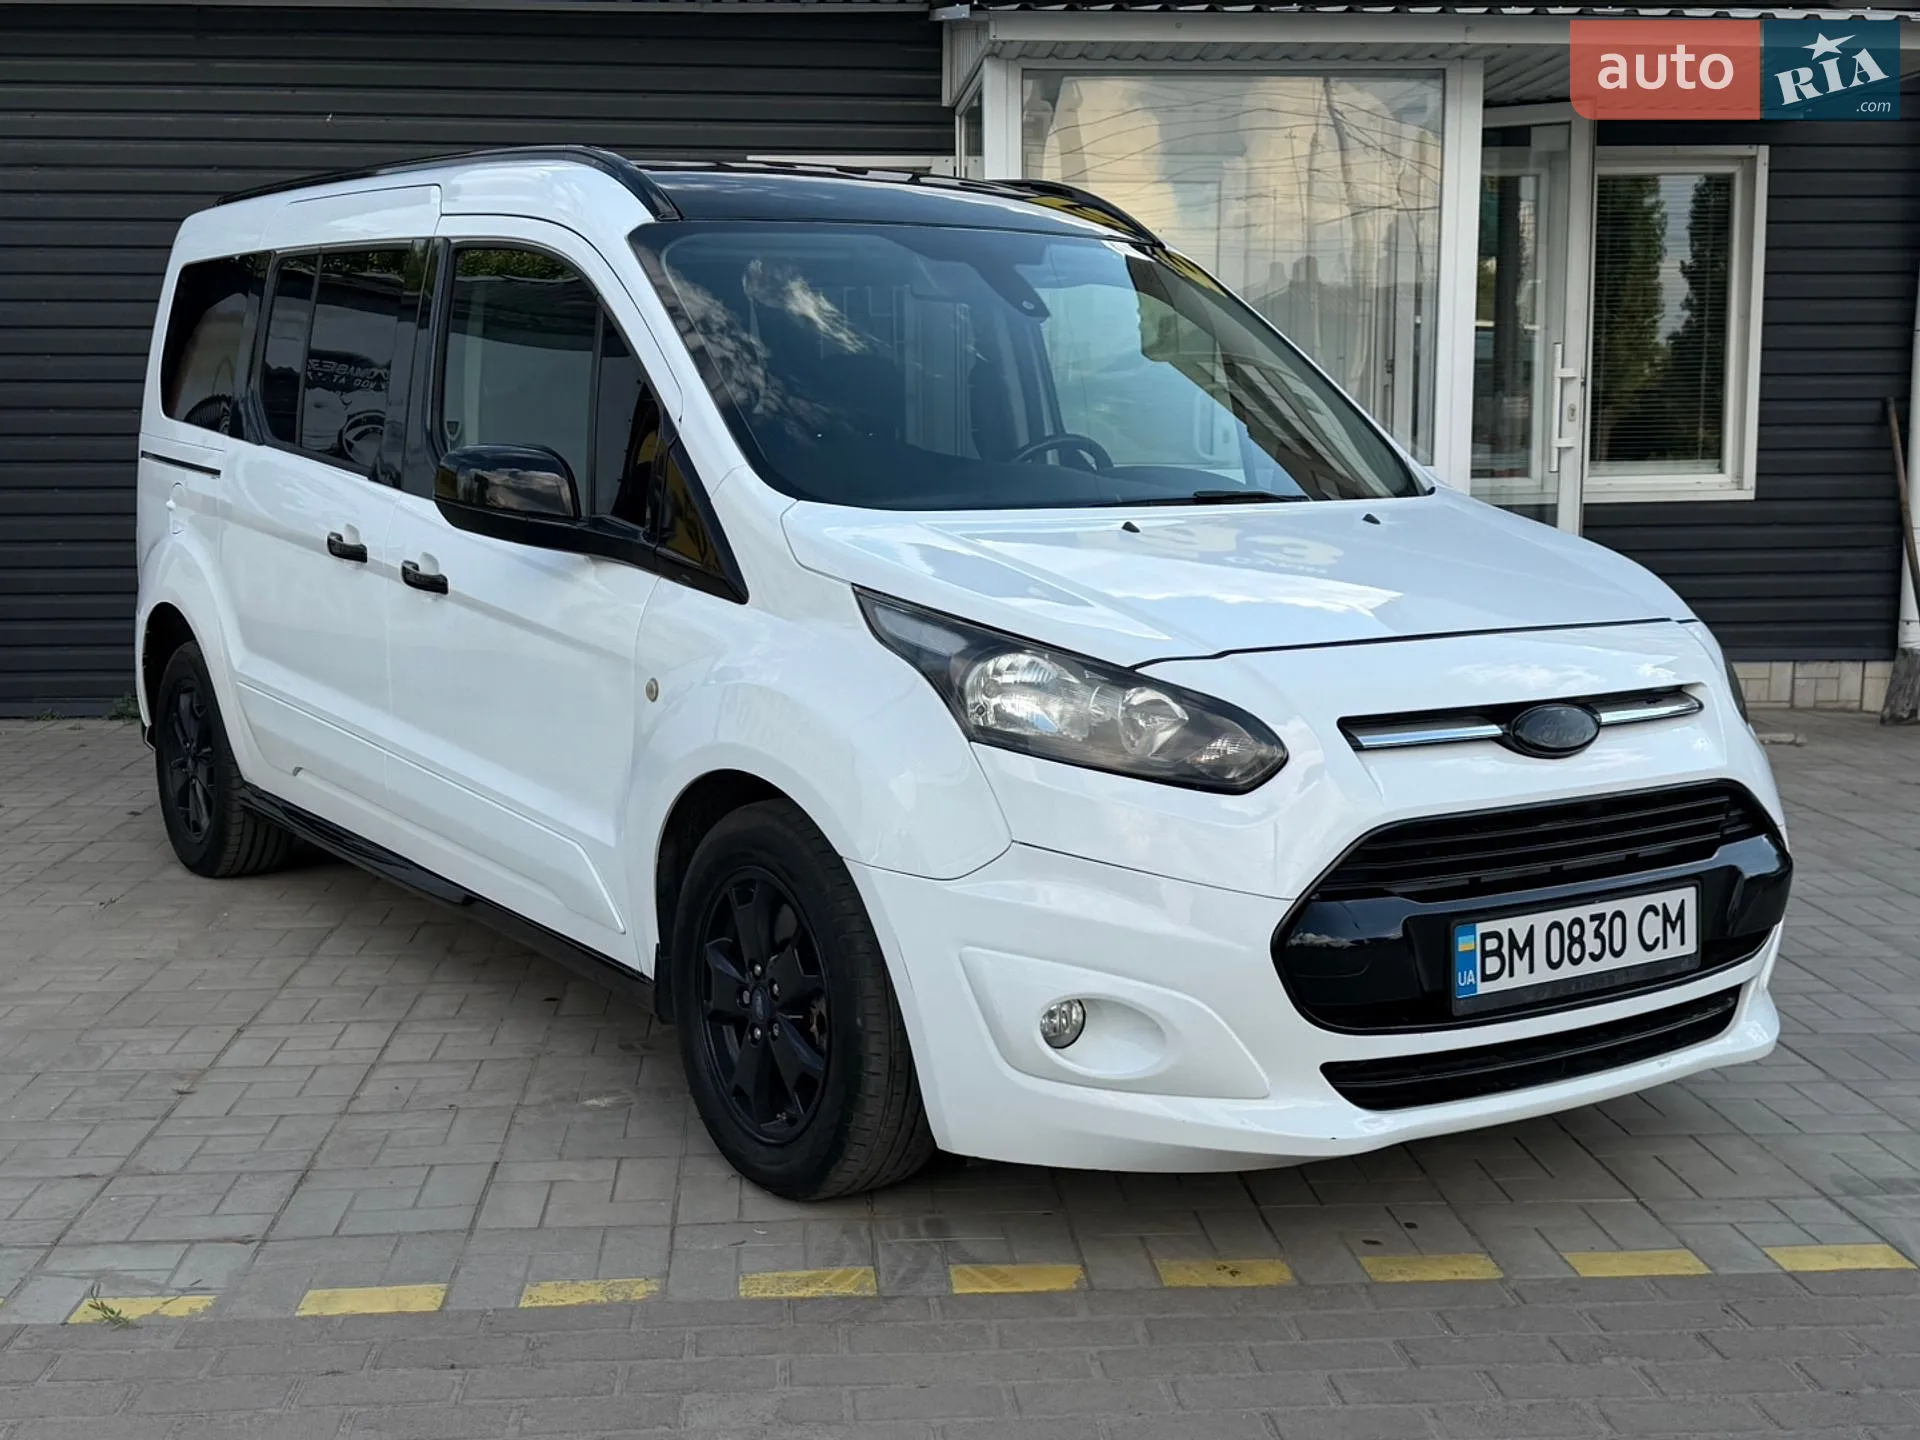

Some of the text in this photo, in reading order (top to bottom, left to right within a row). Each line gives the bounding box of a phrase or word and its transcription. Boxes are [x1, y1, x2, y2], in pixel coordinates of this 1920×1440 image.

[1479, 899, 1685, 982] BM 0830 CM
[1458, 972, 1475, 986] UA
